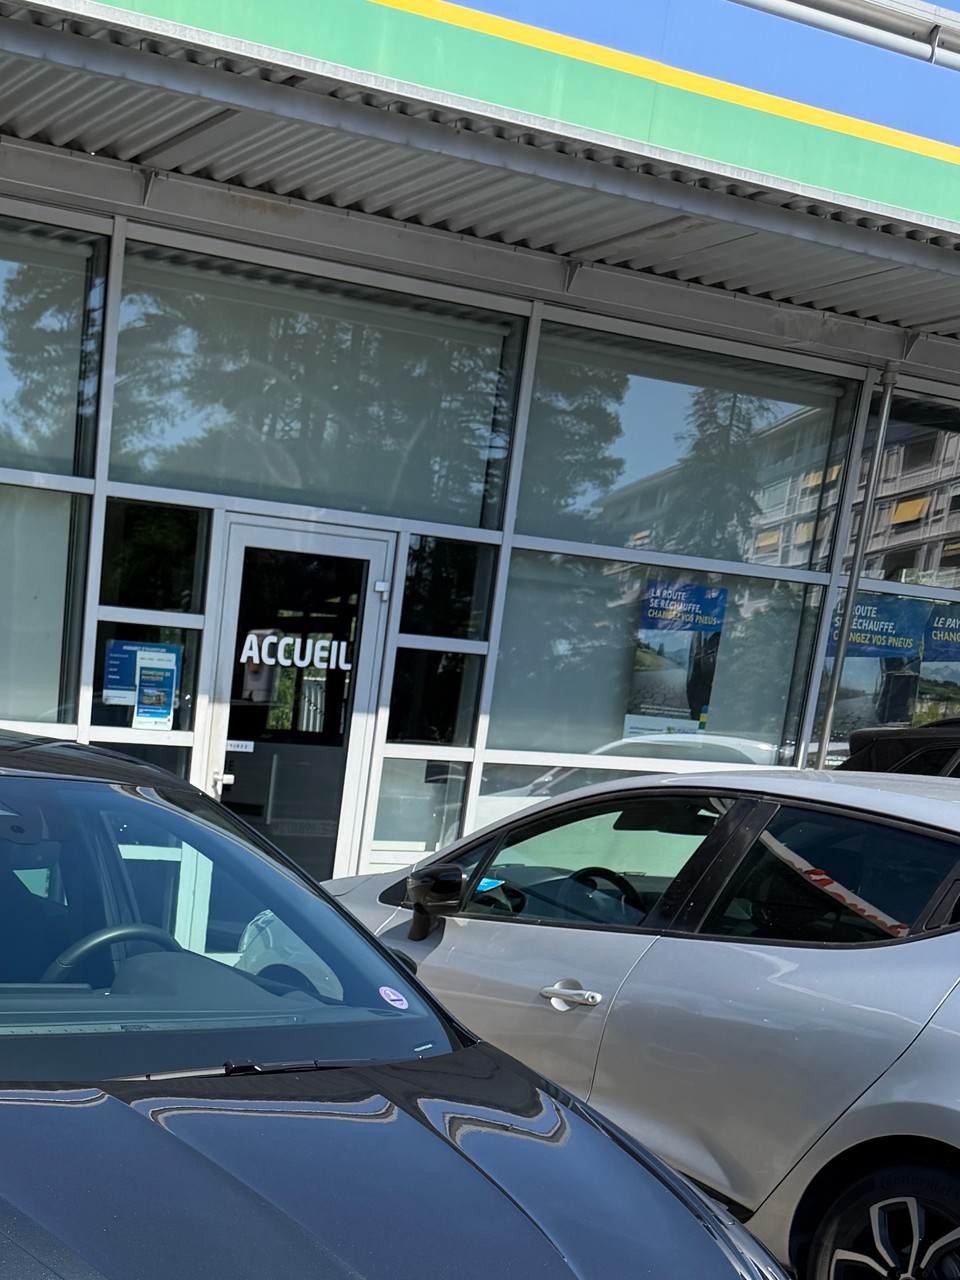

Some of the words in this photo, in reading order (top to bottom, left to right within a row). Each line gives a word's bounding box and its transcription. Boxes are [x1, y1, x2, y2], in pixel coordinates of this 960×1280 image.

[651, 589, 660, 597] LA
[662, 590, 687, 600] ROUTE
[649, 599, 659, 608] SE
[647, 609, 681, 620] CHANGEZ
[695, 615, 718, 625] PNEUS
[852, 605, 878, 617] OUTE
[850, 616, 896, 634] ÉCHAUFFE,
[933, 616, 945, 627] LE
[833, 630, 870, 644] CNGEZ
[871, 634, 886, 646] VOS
[887, 636, 914, 648] PNEUS
[240, 634, 352, 671] ACCUEIL
